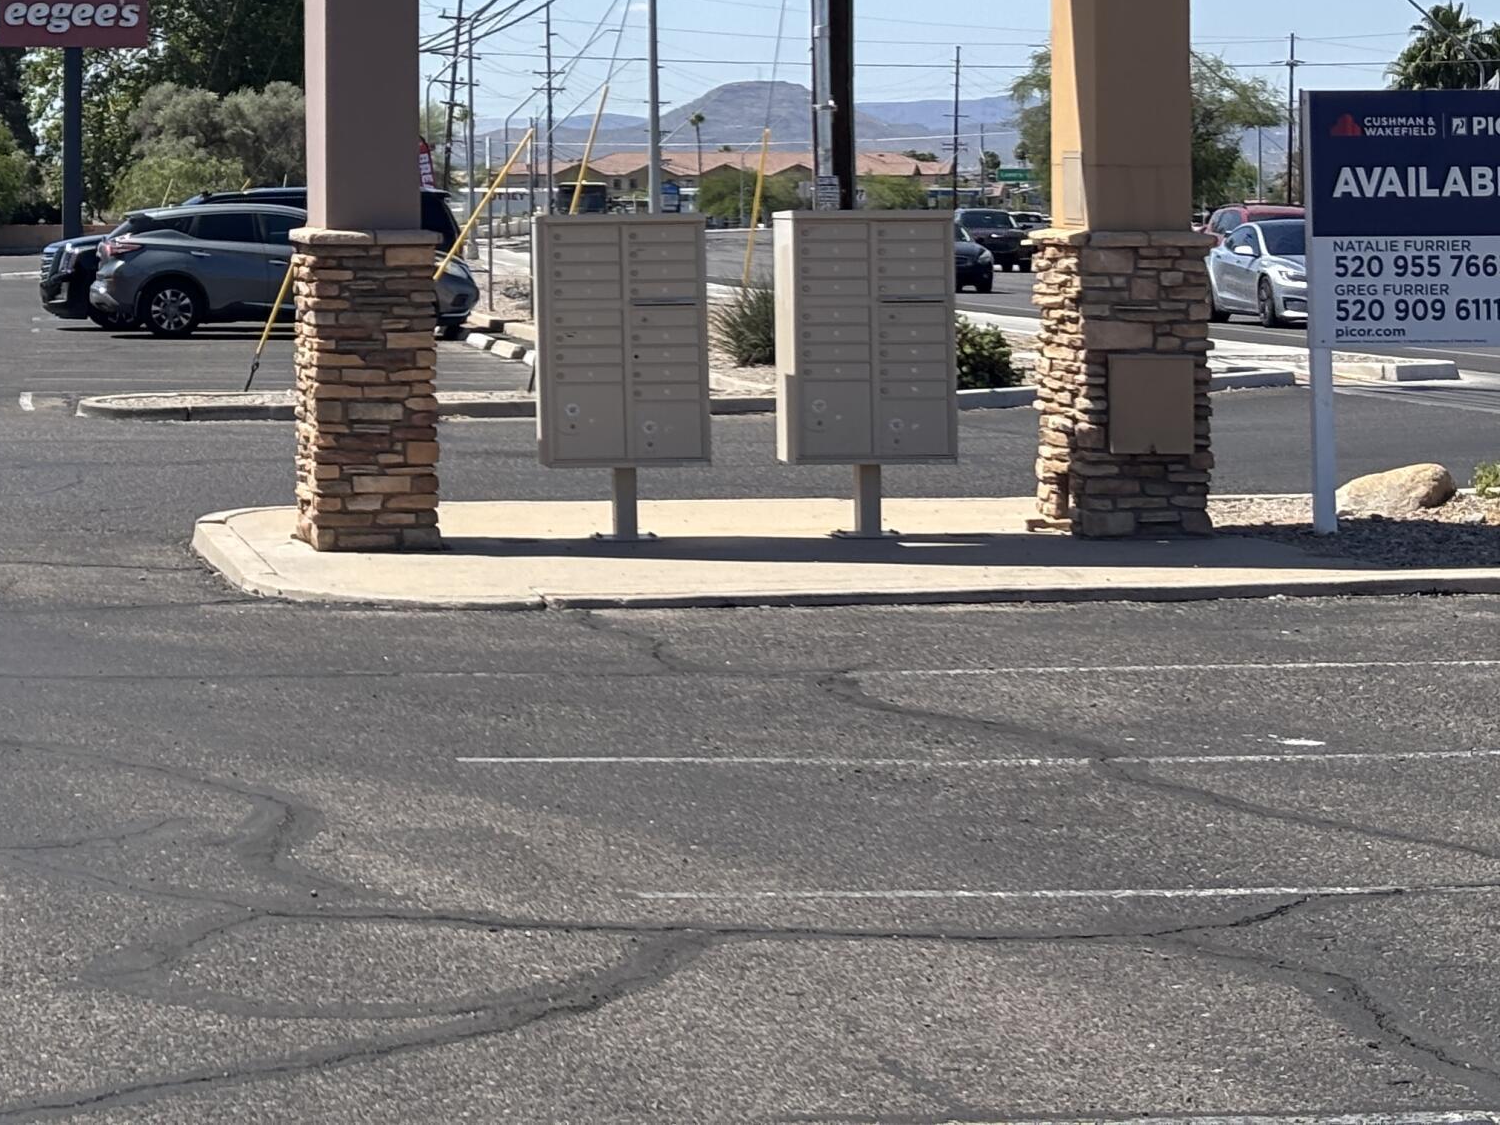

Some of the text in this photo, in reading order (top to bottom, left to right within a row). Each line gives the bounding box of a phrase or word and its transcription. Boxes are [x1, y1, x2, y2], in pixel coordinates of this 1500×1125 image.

[1363, 116, 1436, 126] CUSHMAN &
[1363, 127, 1437, 137] WAKEFIELD
[1332, 166, 1500, 198] AVAILAB
[1333, 239, 1471, 253] NATALIE FURRIER
[1335, 254, 1500, 277] 520 955 766
[1334, 283, 1449, 296] GREG FURRIER
[1335, 298, 1500, 321] 520 909 6111
[1335, 326, 1406, 338] picor.com
